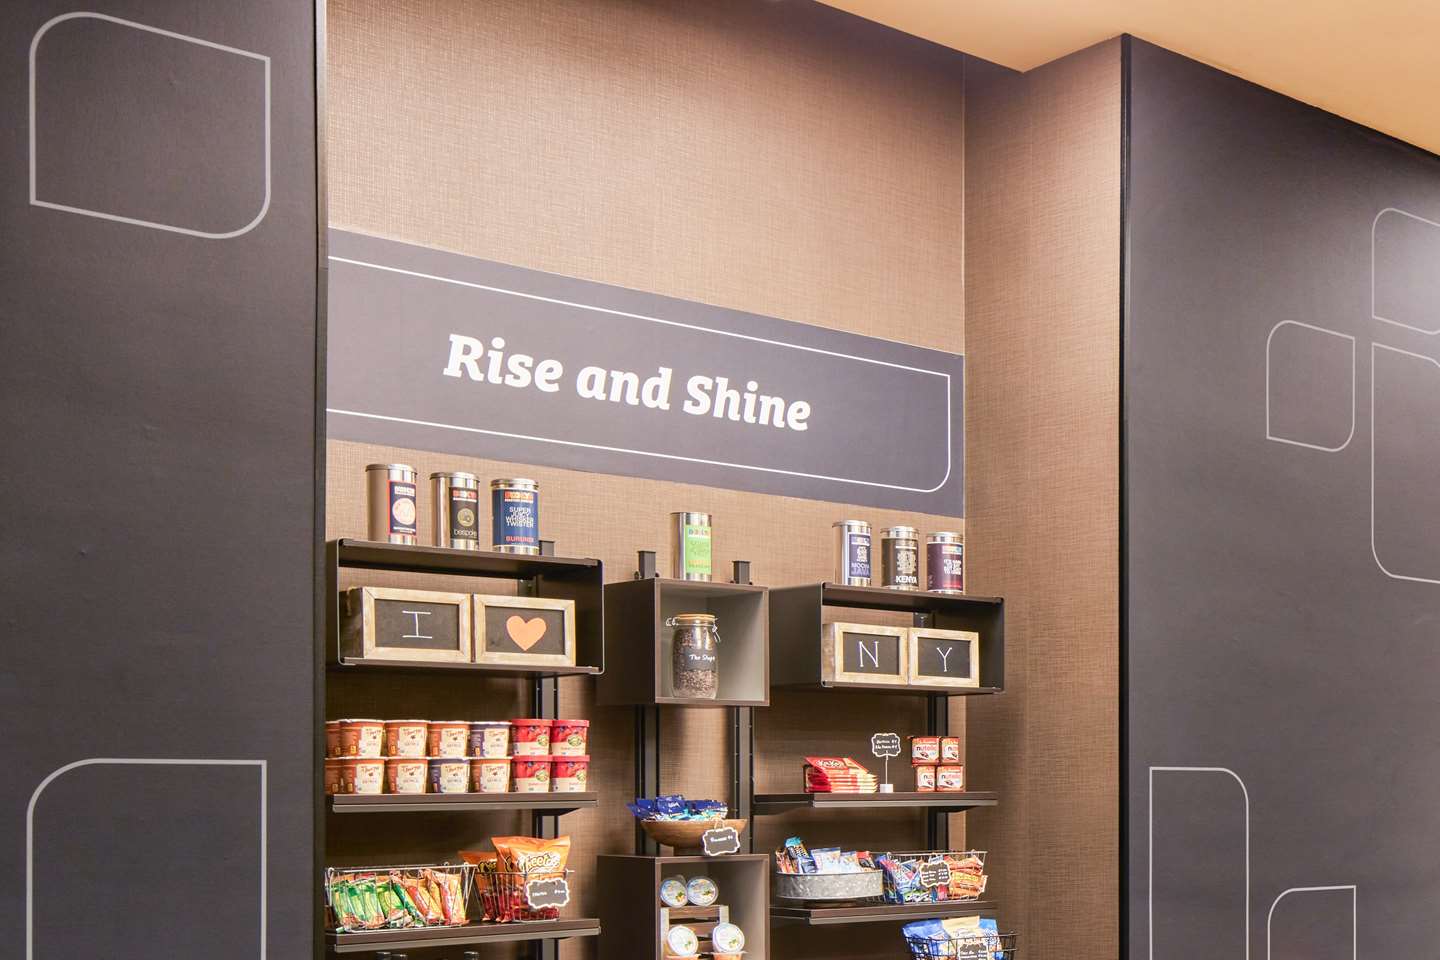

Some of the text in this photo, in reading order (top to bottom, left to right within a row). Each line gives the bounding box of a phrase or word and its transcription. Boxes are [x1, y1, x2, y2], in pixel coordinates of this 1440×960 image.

[443, 333, 812, 431] Rise and Shine
[895, 575, 917, 584] KENYA
[402, 610, 434, 640] I
[857, 640, 879, 668] N
[936, 646, 953, 672] Y
